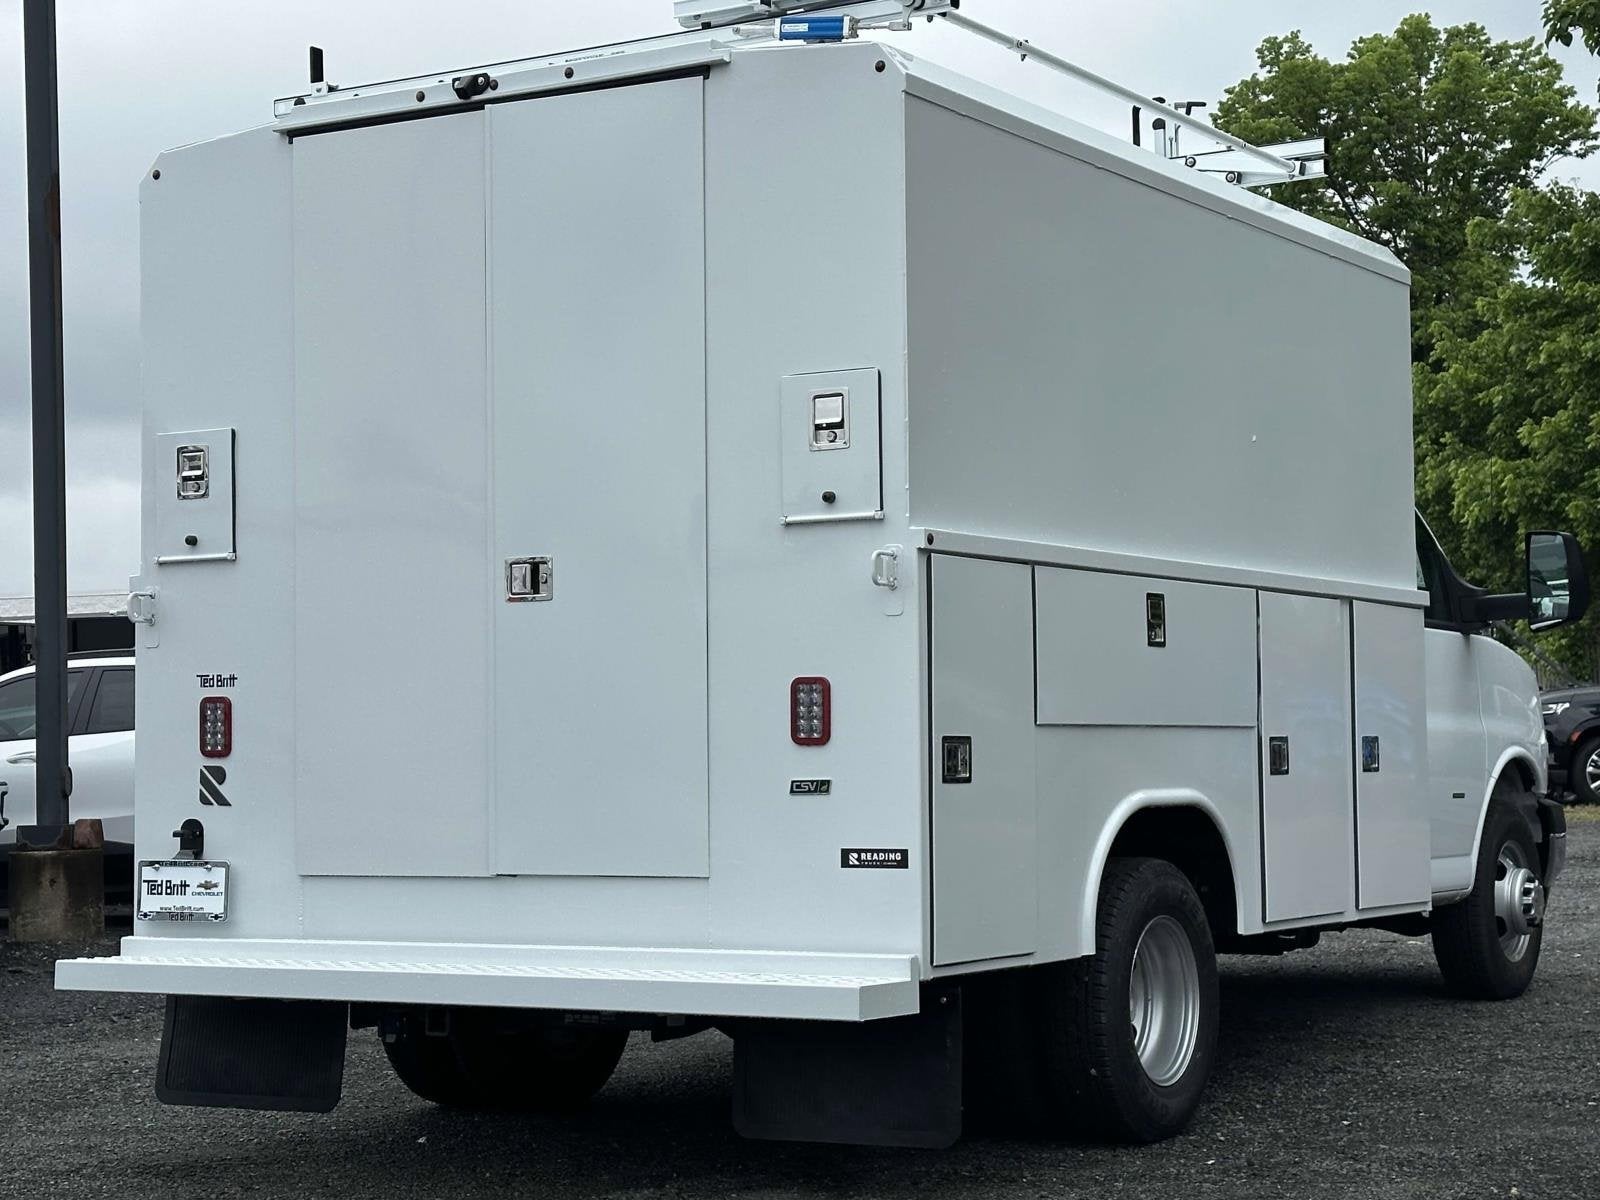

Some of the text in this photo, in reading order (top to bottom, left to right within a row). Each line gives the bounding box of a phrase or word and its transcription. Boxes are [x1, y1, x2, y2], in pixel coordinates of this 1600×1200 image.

[196, 673, 238, 688] Ted Britt
[792, 781, 817, 792] CSV
[860, 852, 902, 861] READING
[143, 879, 190, 896] Ted Britt
[168, 912, 195, 922] Ted Britt
